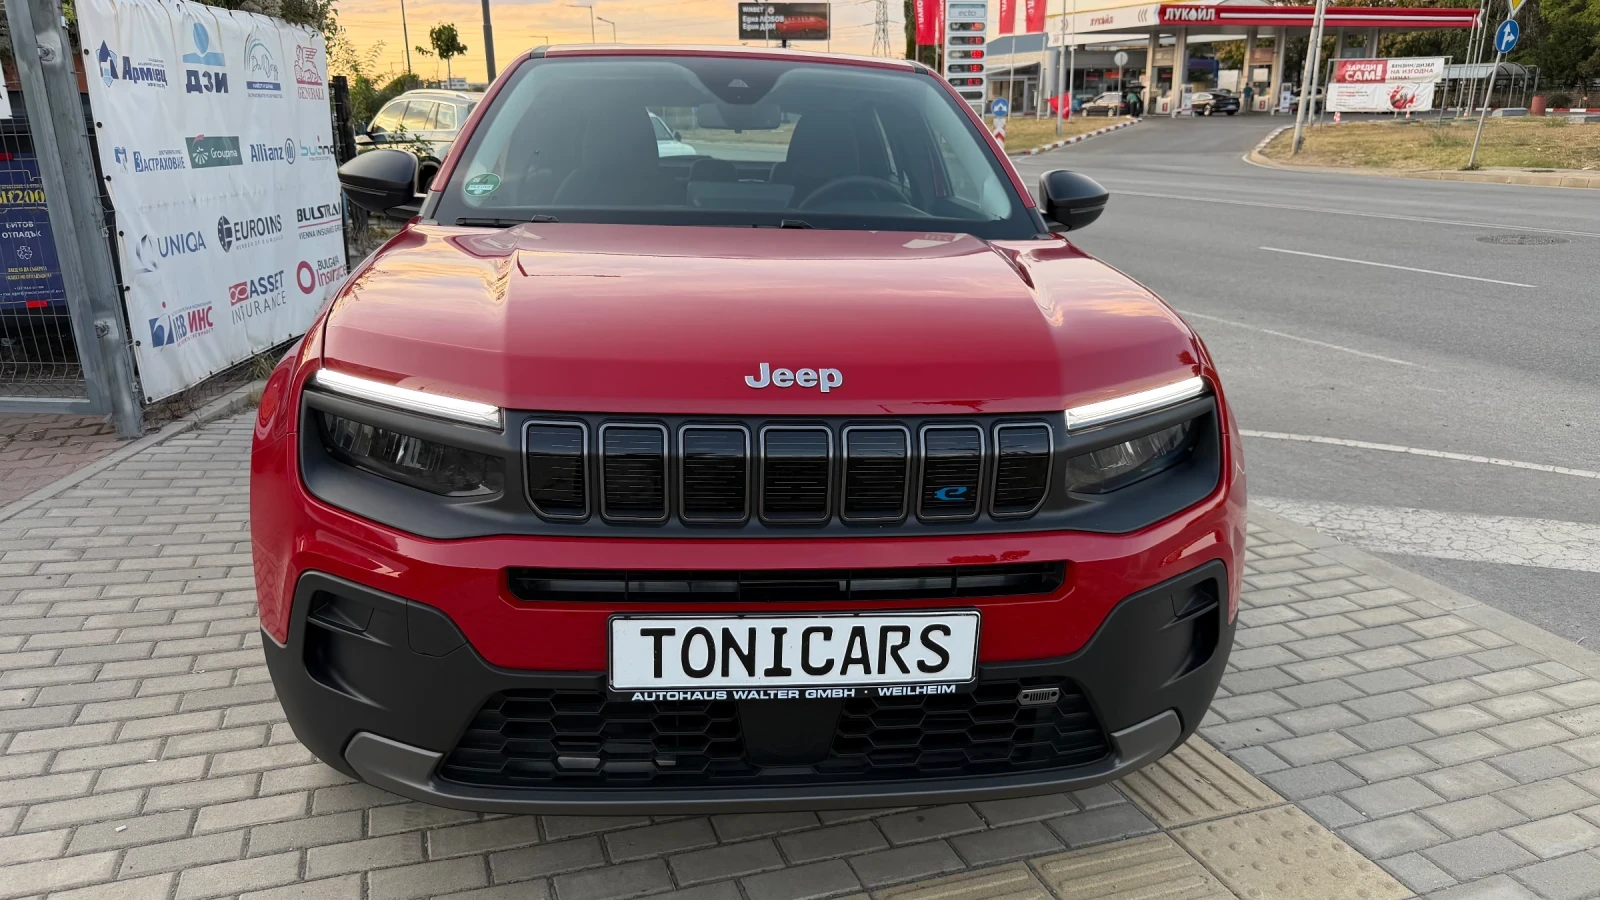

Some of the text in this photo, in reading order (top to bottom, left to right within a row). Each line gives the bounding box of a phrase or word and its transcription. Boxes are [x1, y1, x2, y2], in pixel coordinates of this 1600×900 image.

[1164, 6, 1215, 21] ЛУКОЙЛ
[122, 55, 168, 86] Армец
[186, 69, 229, 94] ДЗИ
[250, 143, 285, 162] Allianz
[234, 214, 283, 242] EUROINS
[157, 230, 206, 258] UNIQA
[250, 270, 284, 298] ASSET
[188, 306, 214, 333] ИНС
[231, 290, 287, 325] INSURANCE
[745, 362, 843, 393] Jeep
[640, 624, 952, 679] TONICARS
[632, 685, 956, 701] AUTOHAUS WALTER GMBH WEILHEIM
